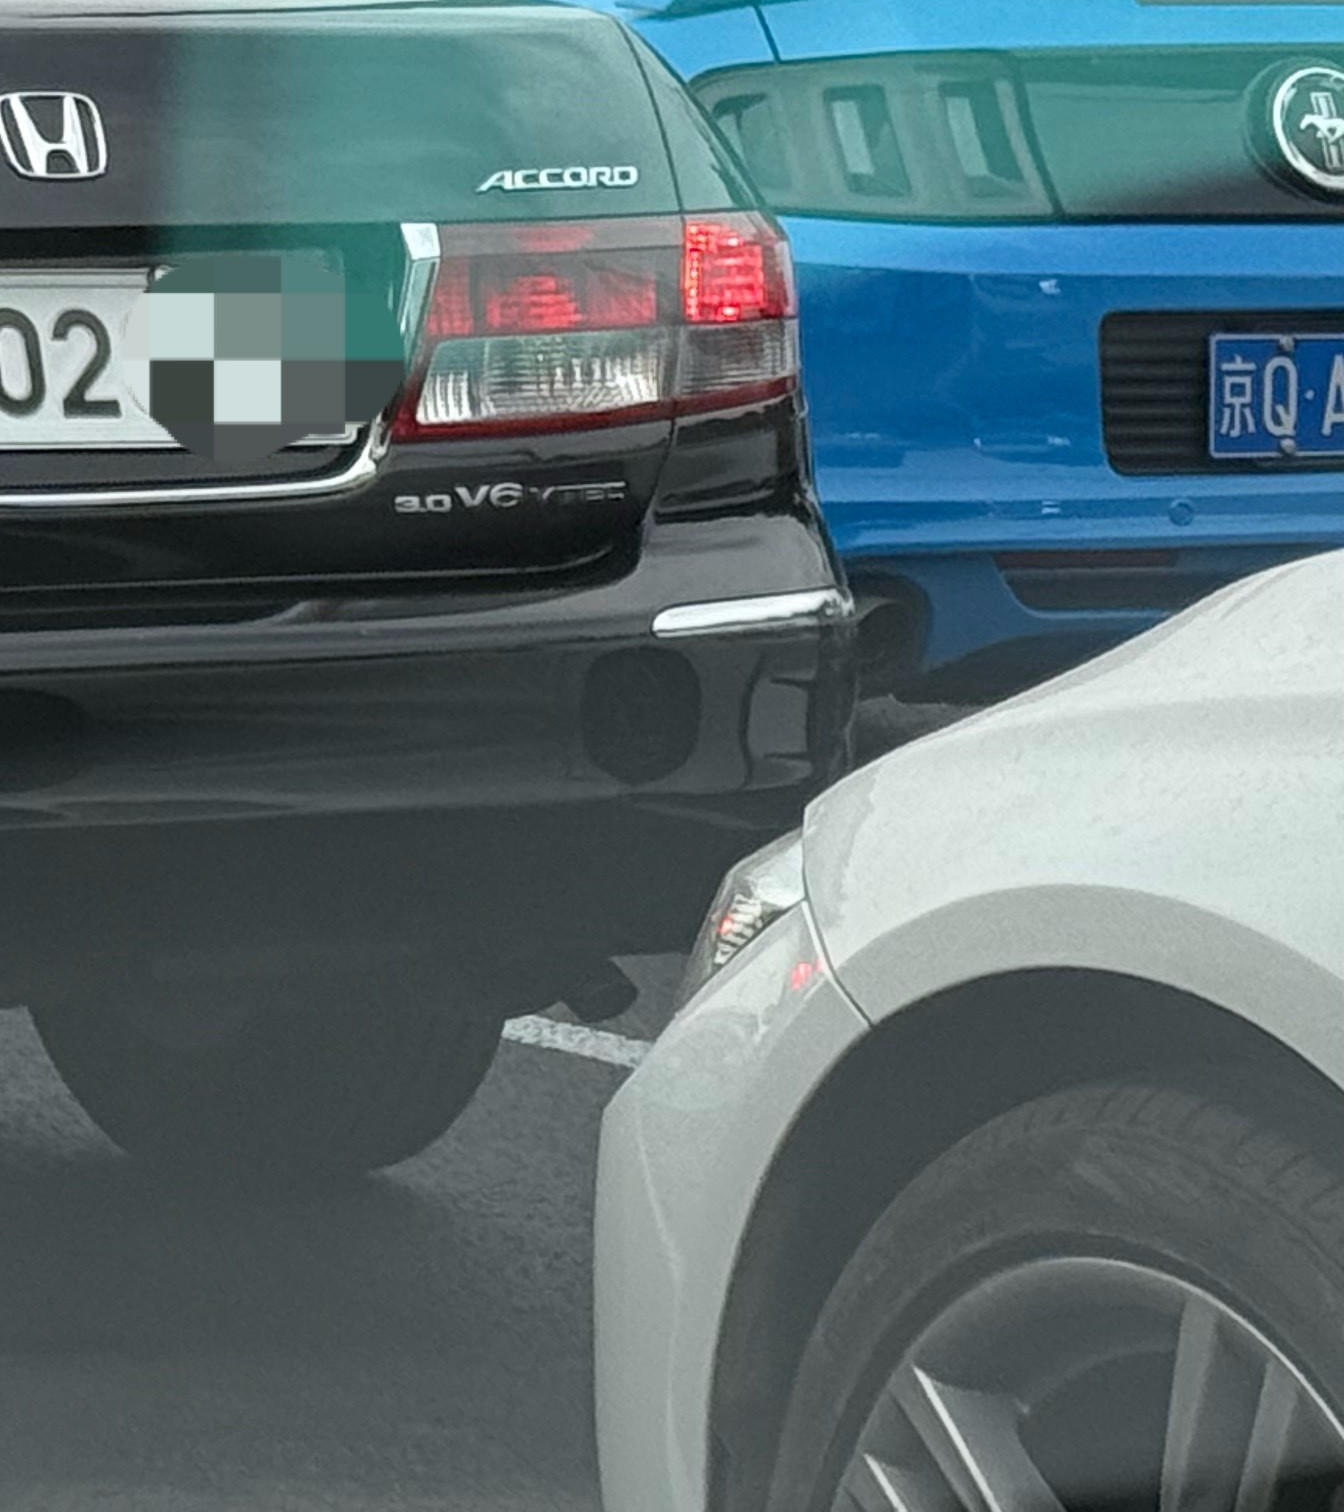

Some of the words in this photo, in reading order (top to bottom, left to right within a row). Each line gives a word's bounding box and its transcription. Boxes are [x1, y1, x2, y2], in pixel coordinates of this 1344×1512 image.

[475, 165, 639, 192] ACCORD
[394, 495, 452, 513] 3.0
[454, 482, 524, 507] V6
